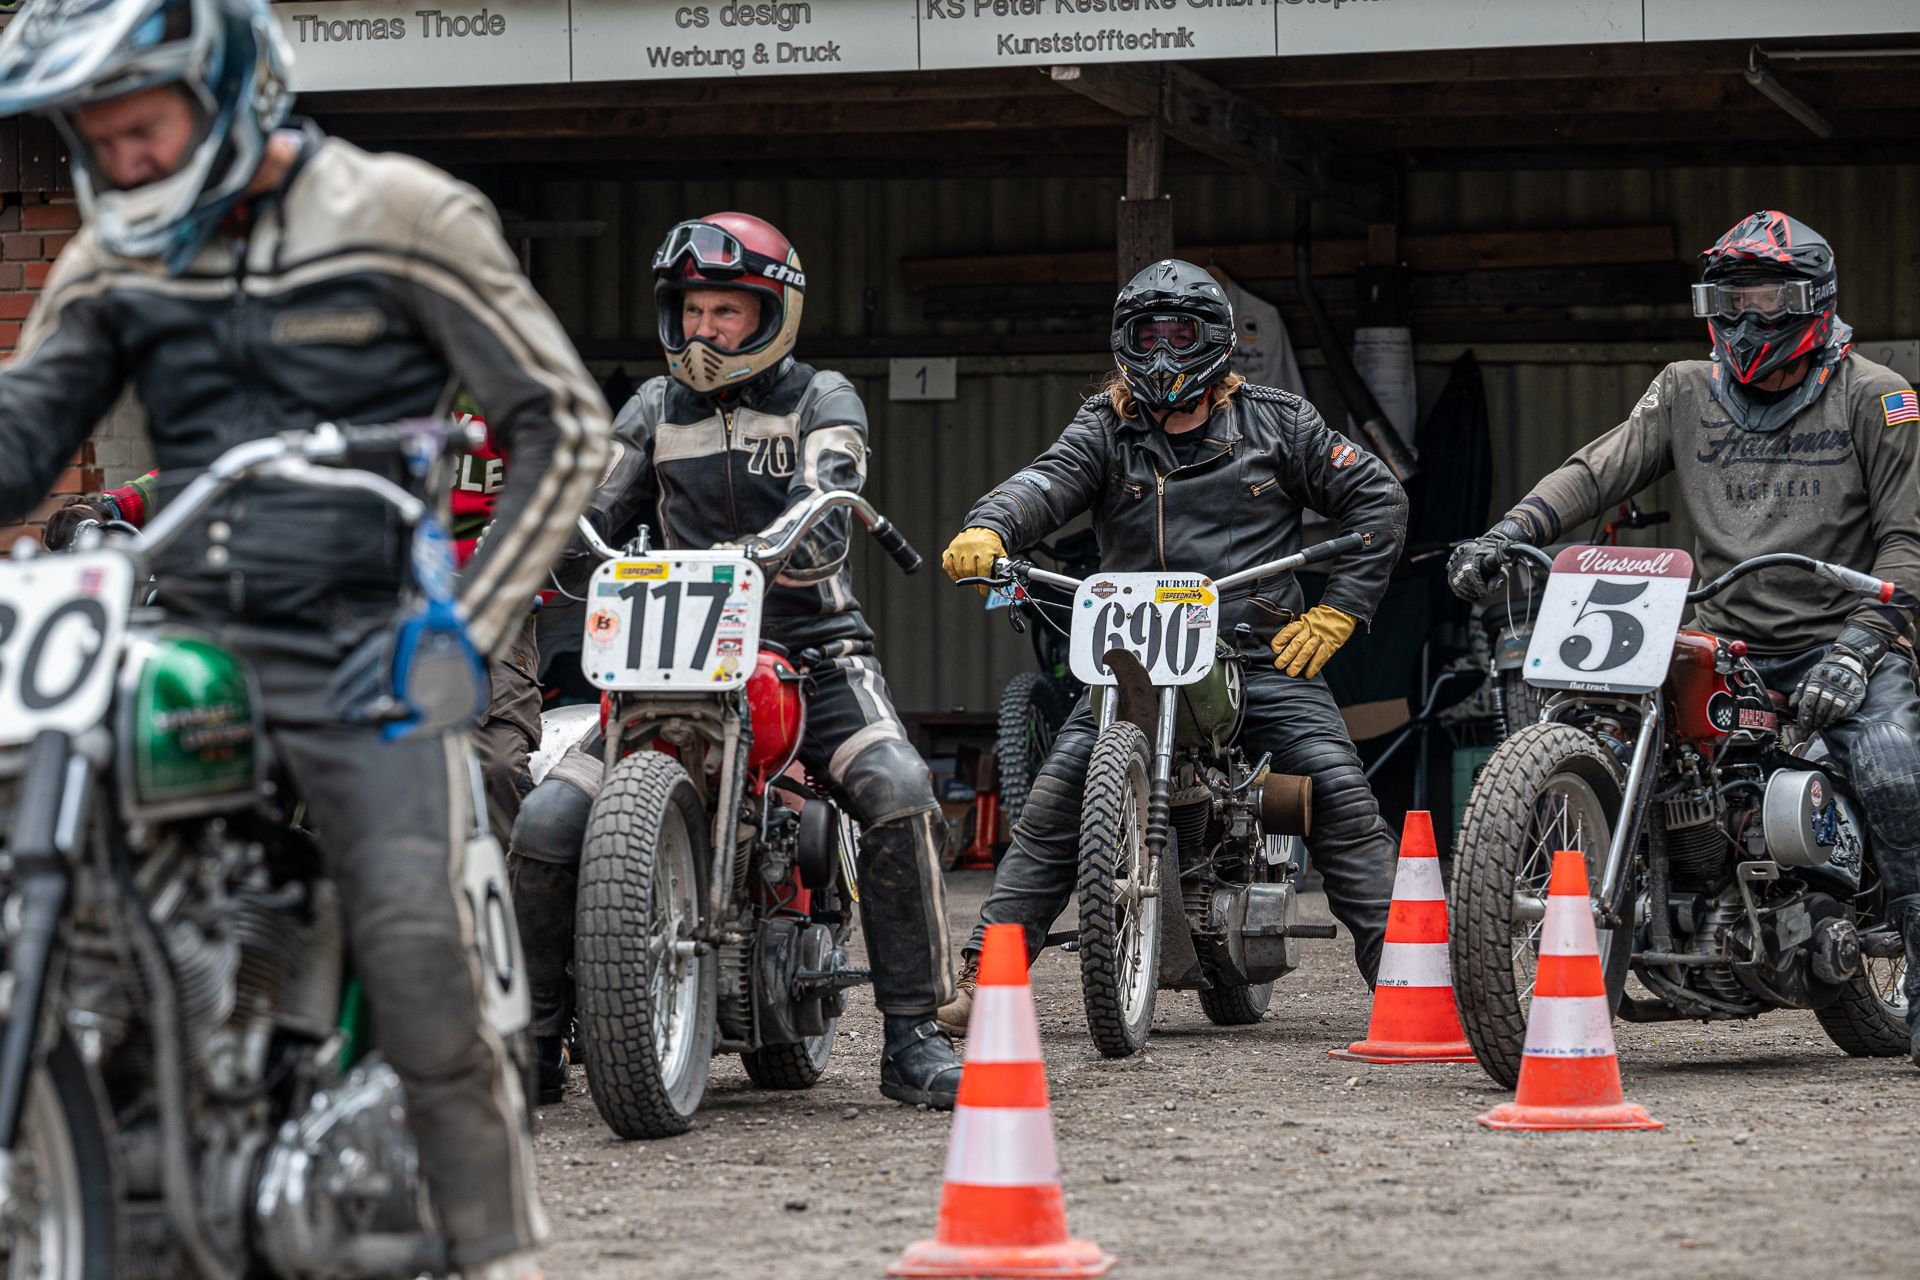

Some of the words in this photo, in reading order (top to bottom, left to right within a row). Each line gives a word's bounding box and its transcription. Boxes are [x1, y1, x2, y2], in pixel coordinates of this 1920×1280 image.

[675, 7, 709, 28] cs
[720, 0, 811, 31] design
[927, 0, 965, 19] KS
[974, 0, 1041, 17] Peter
[293, 14, 406, 42] Thomas
[416, 8, 505, 37] Thode
[646, 45, 745, 70] Werbung
[752, 42, 769, 64] &
[776, 40, 841, 63] Druck
[997, 27, 1194, 55] Kunststofftechnik
[1814, 280, 1836, 302] RAVE
[915, 366, 927, 395] 1
[741, 434, 796, 478] 70
[1577, 548, 1674, 574] Vinsvoll
[617, 581, 733, 671] 117
[1092, 602, 1200, 677] 690
[1559, 579, 1649, 672] 5
